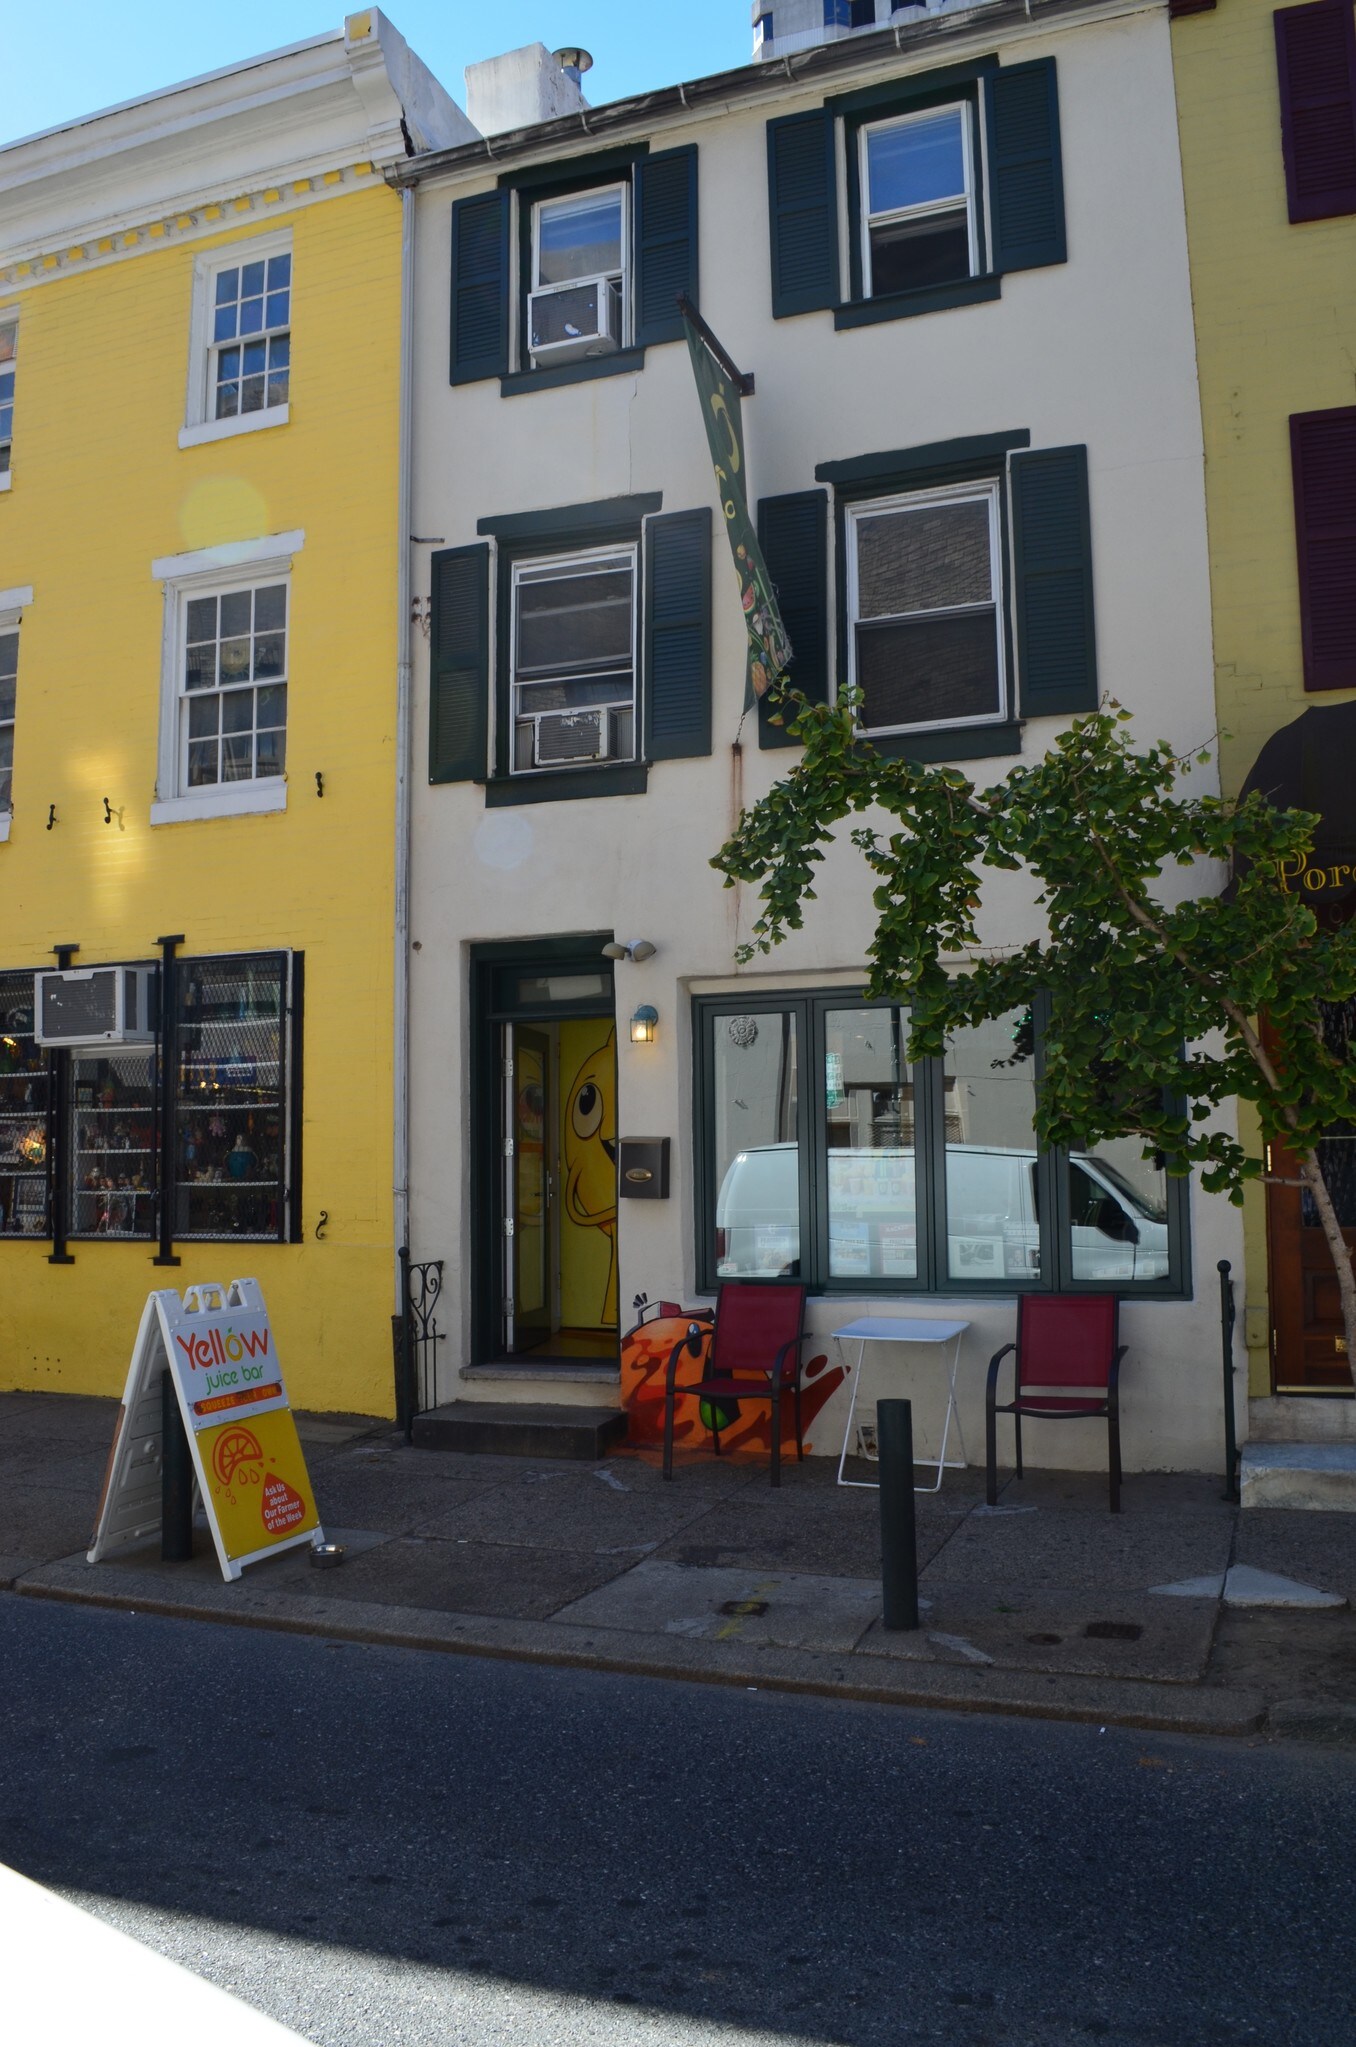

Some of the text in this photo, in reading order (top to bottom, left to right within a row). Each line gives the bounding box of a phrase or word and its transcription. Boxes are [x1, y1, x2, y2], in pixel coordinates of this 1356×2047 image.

[1272, 849, 1356, 895] Por
[204, 1365, 264, 1396] juice bar
[200, 1397, 236, 1412] SQUEEZE
[265, 1483, 286, 1497] Ask Us
[269, 1492, 288, 1506] about
[264, 1501, 300, 1519] Our Farmer
[267, 1511, 302, 1530] of the Week
